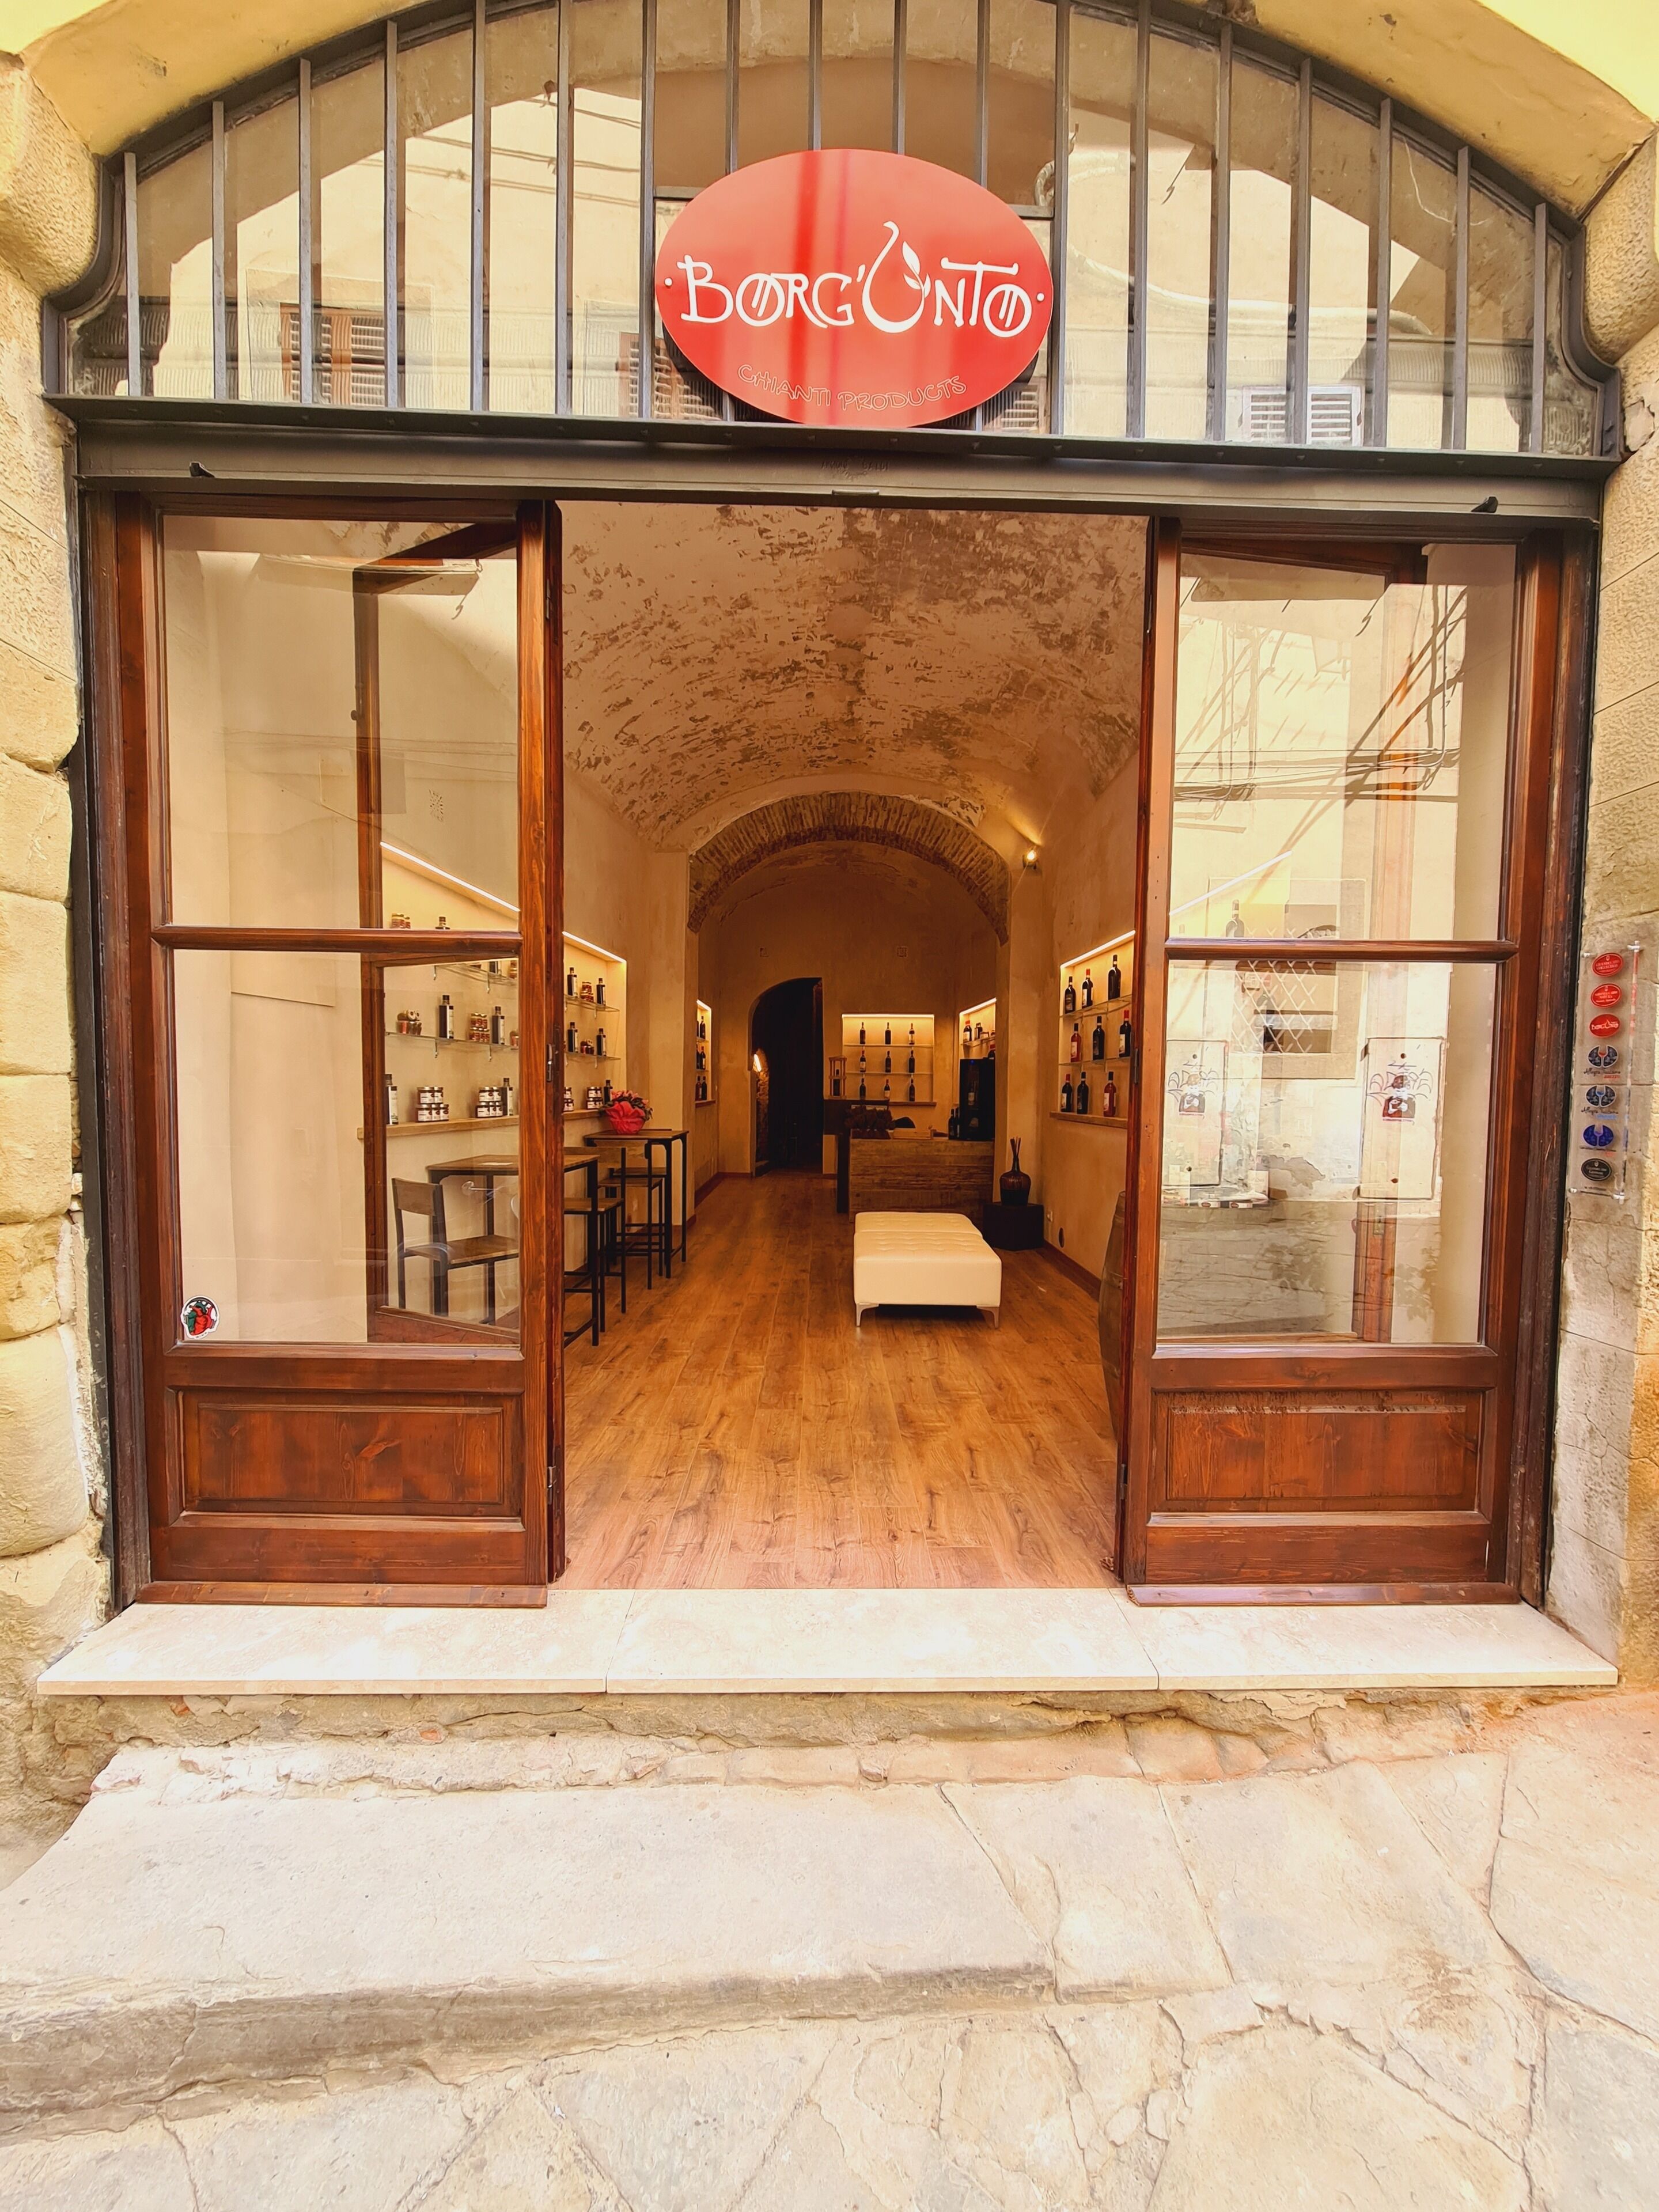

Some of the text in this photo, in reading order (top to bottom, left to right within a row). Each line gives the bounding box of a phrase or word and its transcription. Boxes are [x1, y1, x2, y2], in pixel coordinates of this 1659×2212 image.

[676, 221, 1033, 338] BORG'UNTO
[737, 364, 967, 411] CHIANTI PRODUCTS
